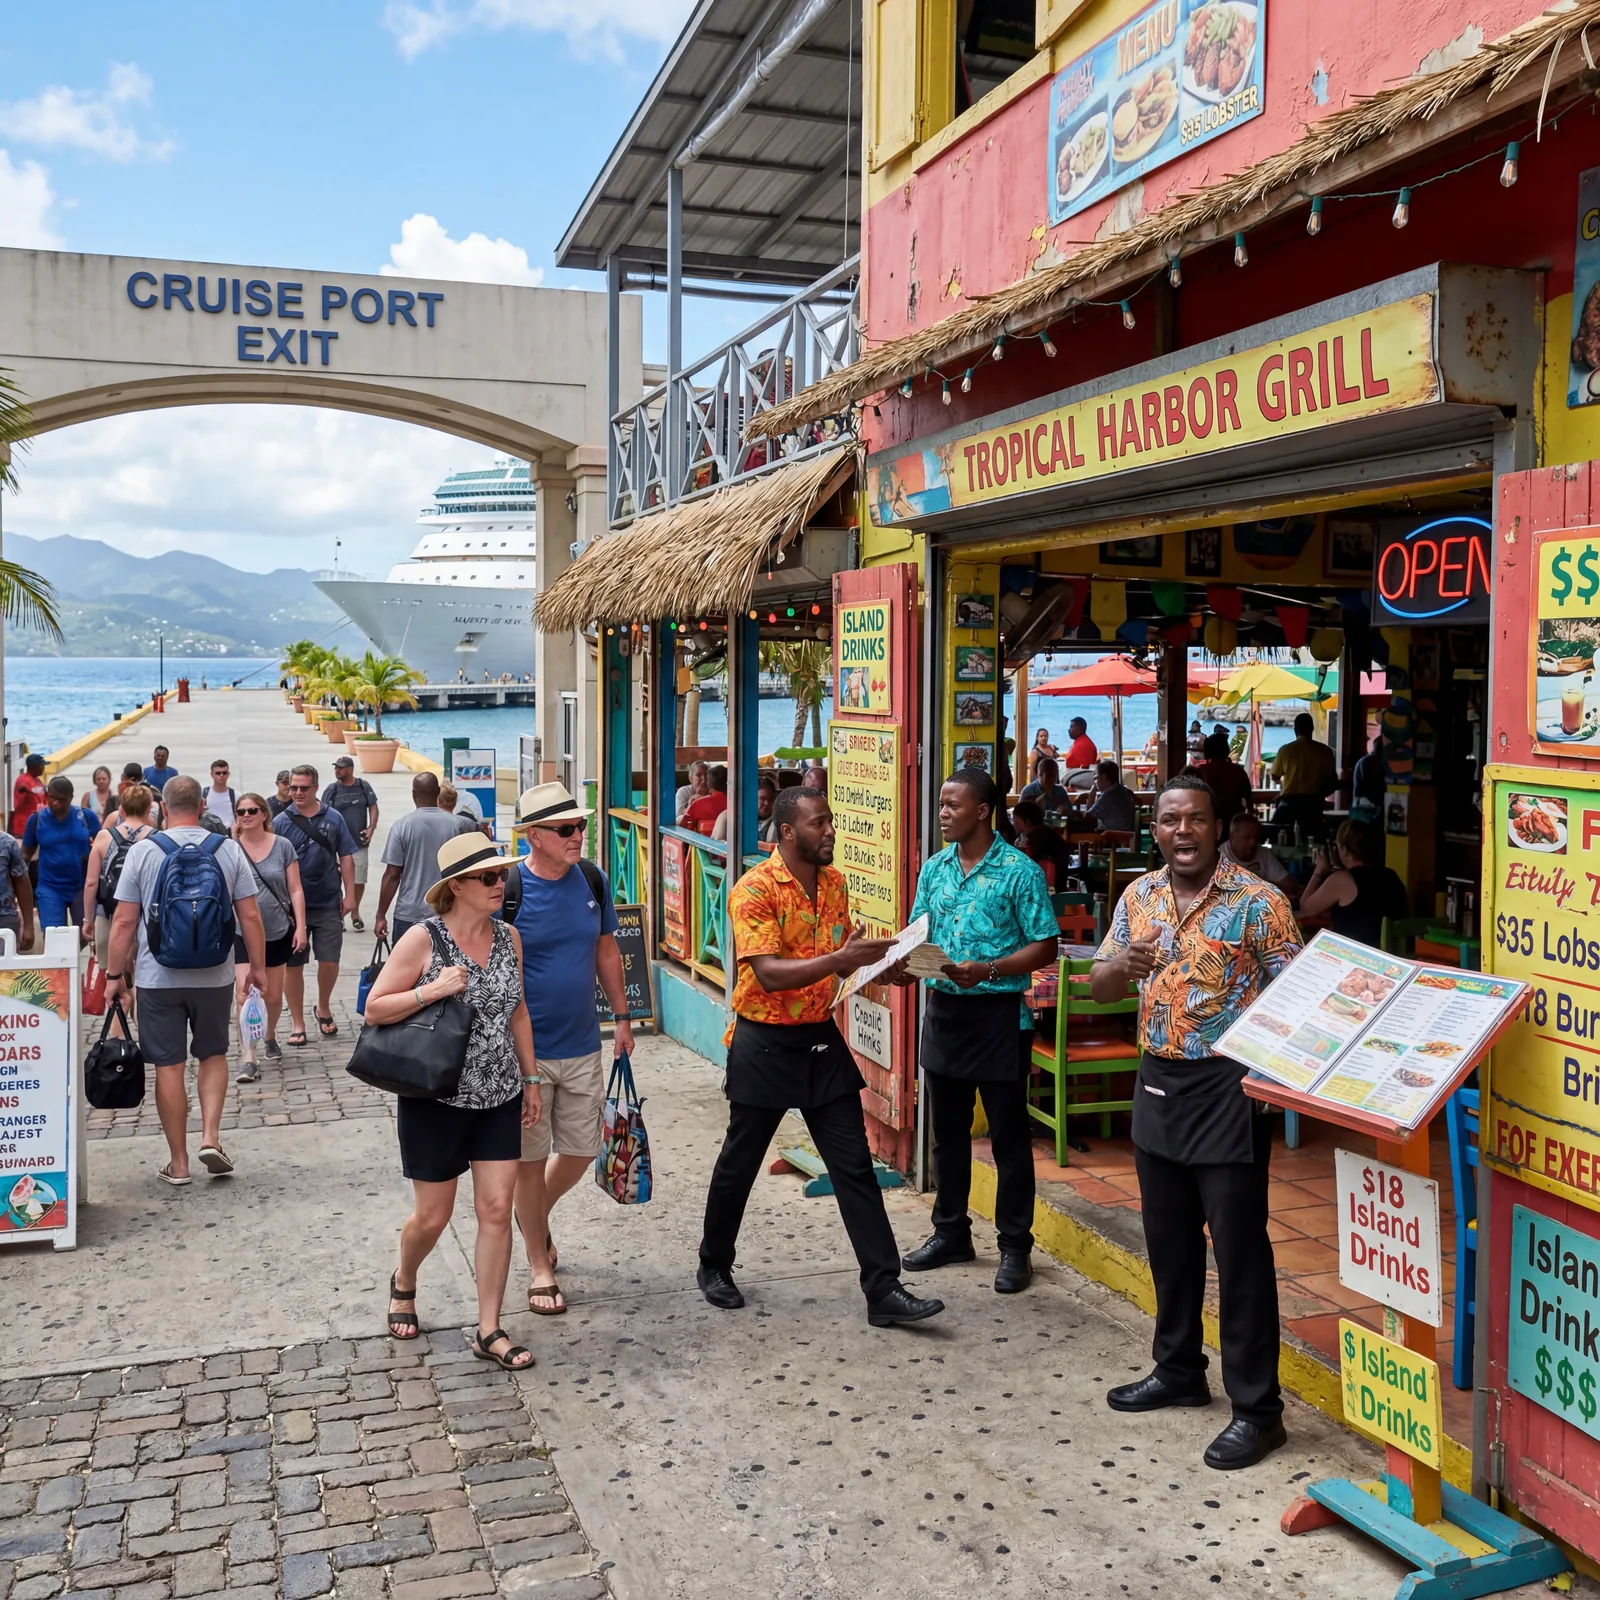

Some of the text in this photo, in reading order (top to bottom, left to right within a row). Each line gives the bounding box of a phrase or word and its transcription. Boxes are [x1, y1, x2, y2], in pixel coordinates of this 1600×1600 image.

[1117, 1, 1178, 78] MENU
[1180, 84, 1259, 146] $35 LOBSTER
[127, 271, 444, 327] CRUISE PORT
[237, 325, 339, 366] EXIT
[964, 327, 1390, 492] TROPICAL HARBOR GRILL
[1378, 535, 1491, 600] OPEN
[842, 637, 885, 661] DRINKS
[843, 609, 885, 634] ISLAND
[865, 789, 892, 814] Burgers
[881, 819, 892, 841] $8
[878, 851, 892, 872] $18
[1496, 911, 1600, 971] $35 Lobs
[1515, 988, 1548, 1027] 18
[0, 1128, 43, 1141] AJEST
[1497, 1118, 1537, 1168] FOF
[1362, 1166, 1405, 1209] $18
[1350, 1192, 1420, 1249] Island
[1350, 1231, 1430, 1295] Drinks
[1529, 1222, 1598, 1299] Islan
[1520, 1278, 1600, 1364] Drink
[1344, 1329, 1356, 1364] $
[1361, 1337, 1427, 1403] Island
[1534, 1344, 1597, 1424] $$$
[1360, 1384, 1432, 1453] Drinks
